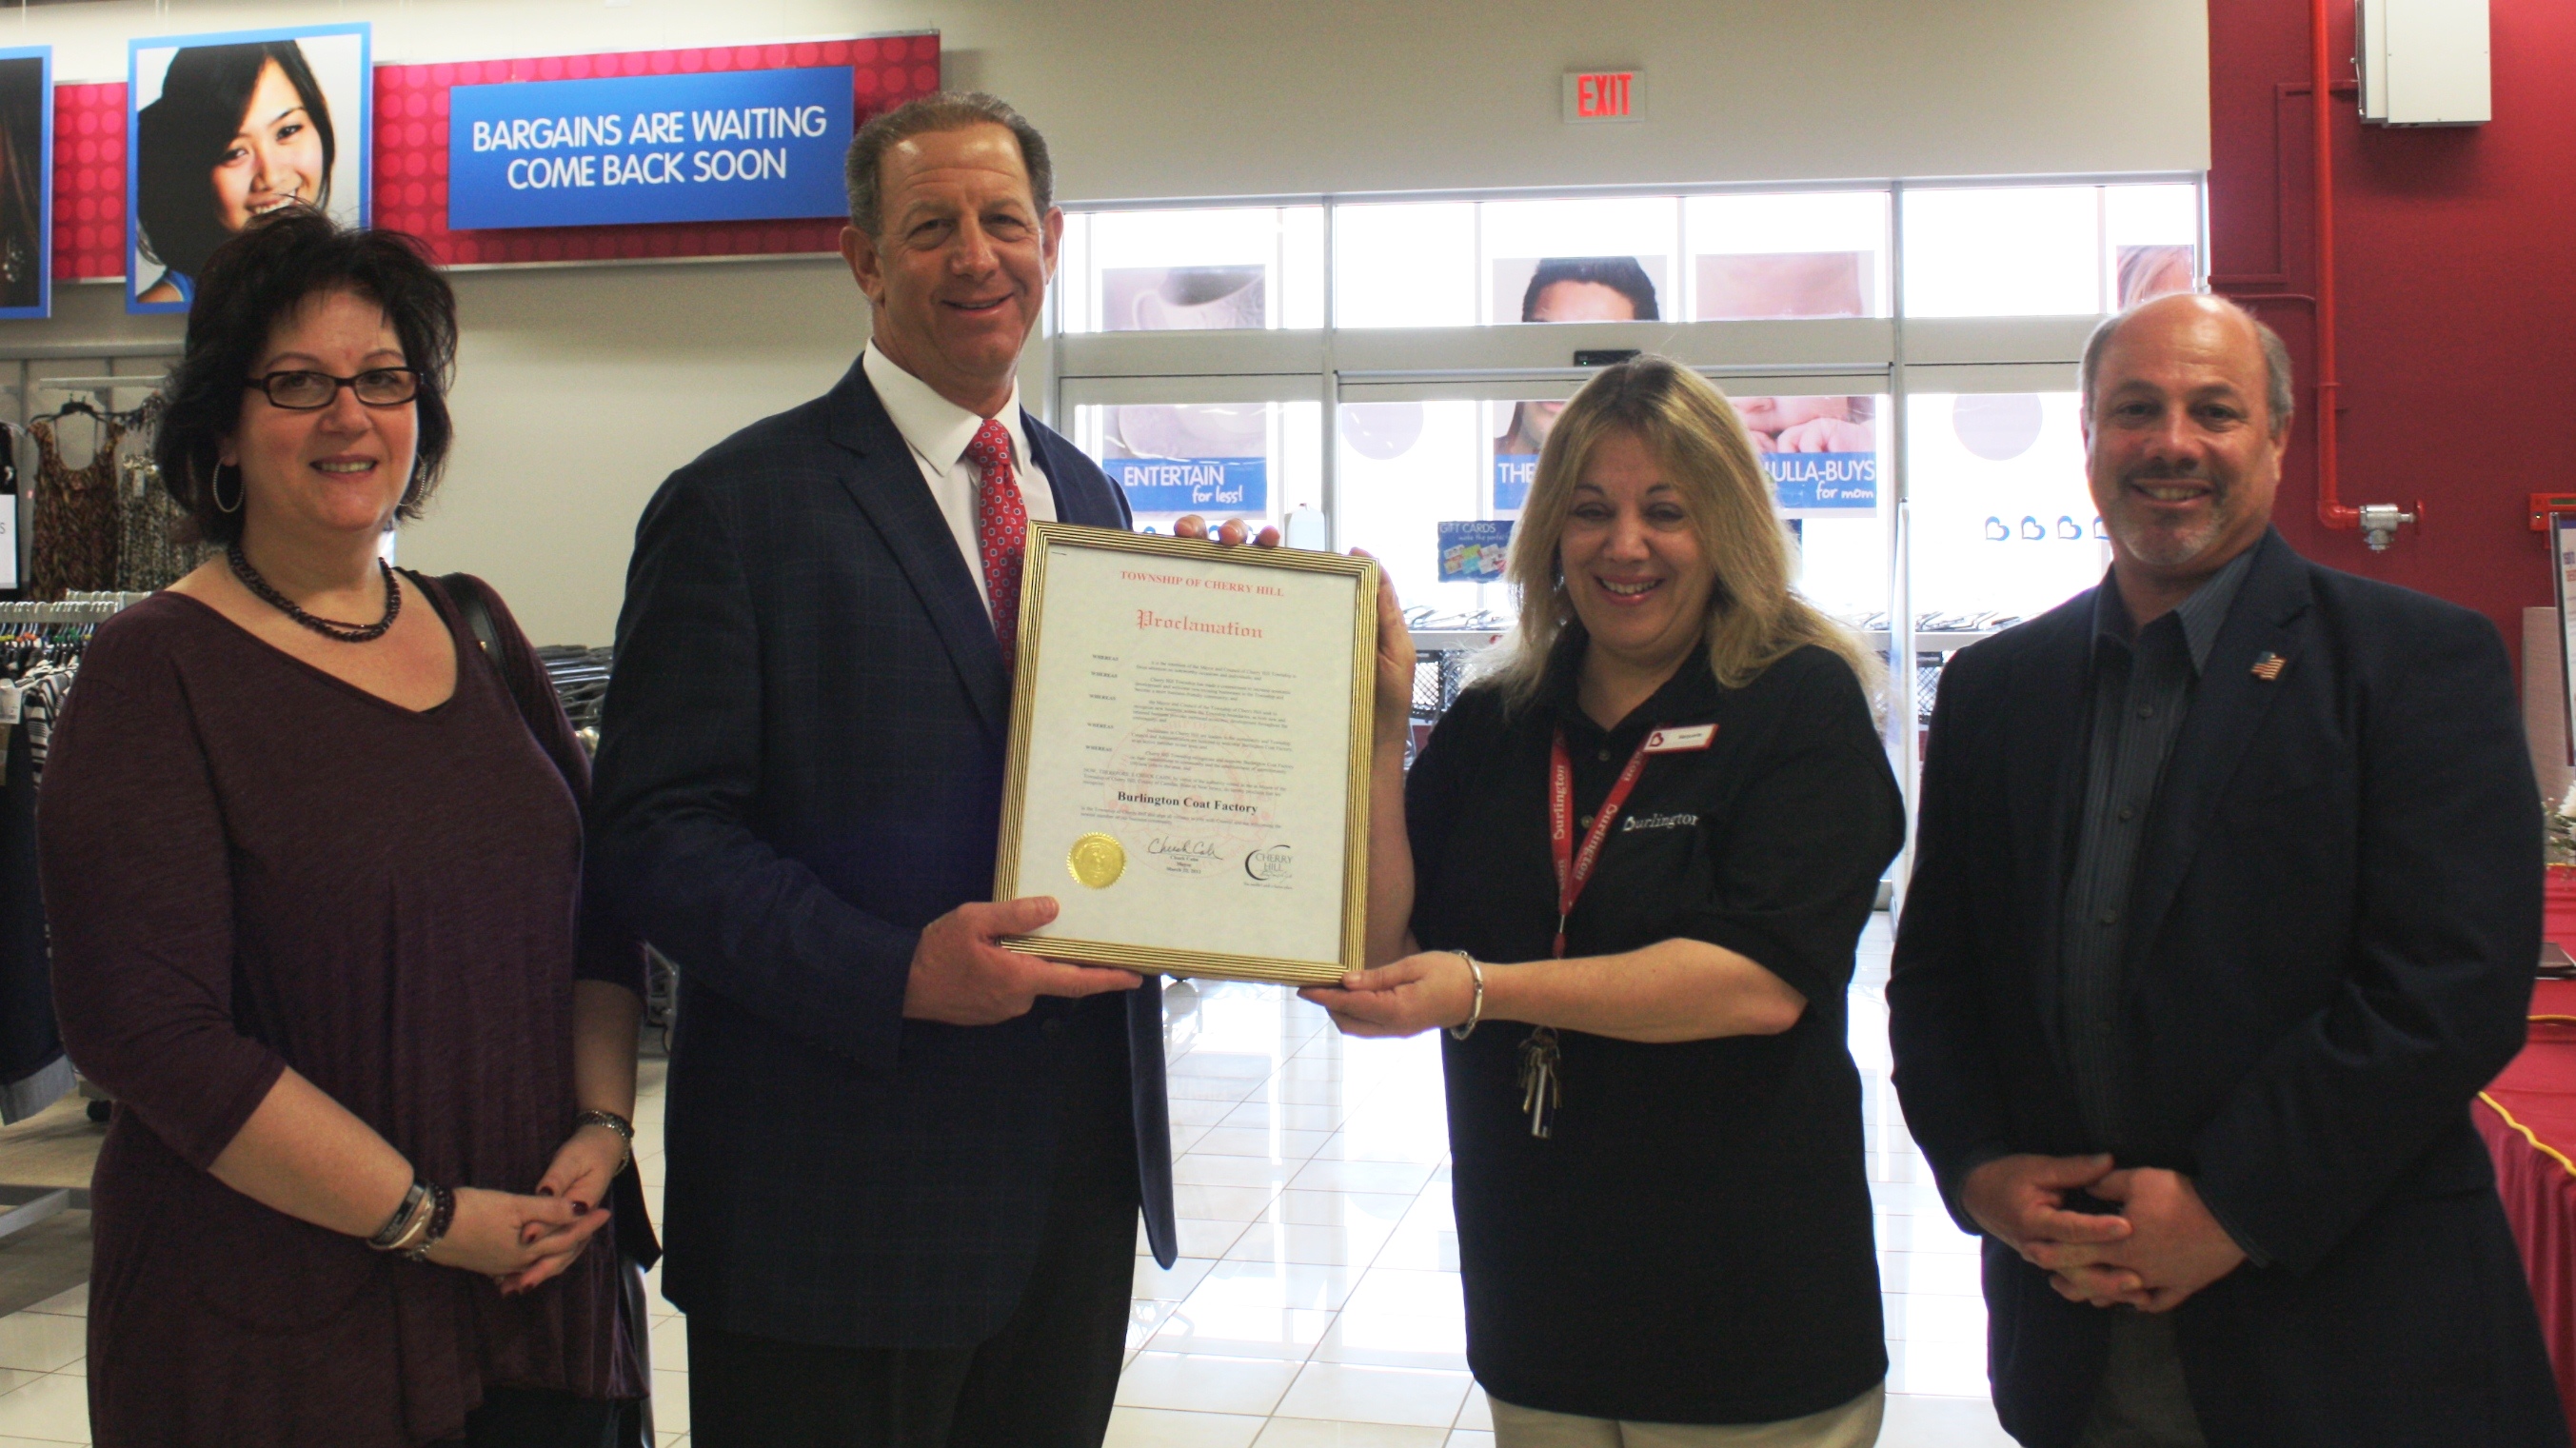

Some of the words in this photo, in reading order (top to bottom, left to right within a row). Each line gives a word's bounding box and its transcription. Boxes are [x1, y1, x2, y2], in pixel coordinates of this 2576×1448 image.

[1577, 72, 1633, 116] EXIT
[473, 115, 623, 151] BARGAINS
[629, 111, 684, 145] ARE
[692, 106, 827, 142] WAITING
[507, 155, 595, 189] COME
[603, 152, 684, 186] BACK
[693, 148, 786, 182] SOON
[1124, 466, 1224, 486] ENTERTAIN
[1192, 485, 1213, 504] for
[1216, 485, 1243, 504] less!
[1816, 480, 1838, 500] for
[1841, 487, 1873, 499] mom
[1439, 524, 1460, 532] GIFT
[1462, 523, 1496, 533] CARDS
[1120, 570, 1182, 585] TOWNSHIP
[1185, 577, 1201, 587] OF
[1203, 579, 1252, 593] CHERRY
[1256, 585, 1284, 596] HILL
[1136, 608, 1263, 642] Proclamation
[1117, 790, 1179, 808] Burlington
[1182, 797, 1210, 809] Coat
[1213, 800, 1258, 815] Factory
[1554, 764, 1567, 840] Burlington
[1576, 803, 1618, 882] Burlington
[1255, 852, 1292, 863] CHERRY
[1263, 862, 1283, 872] HILL
